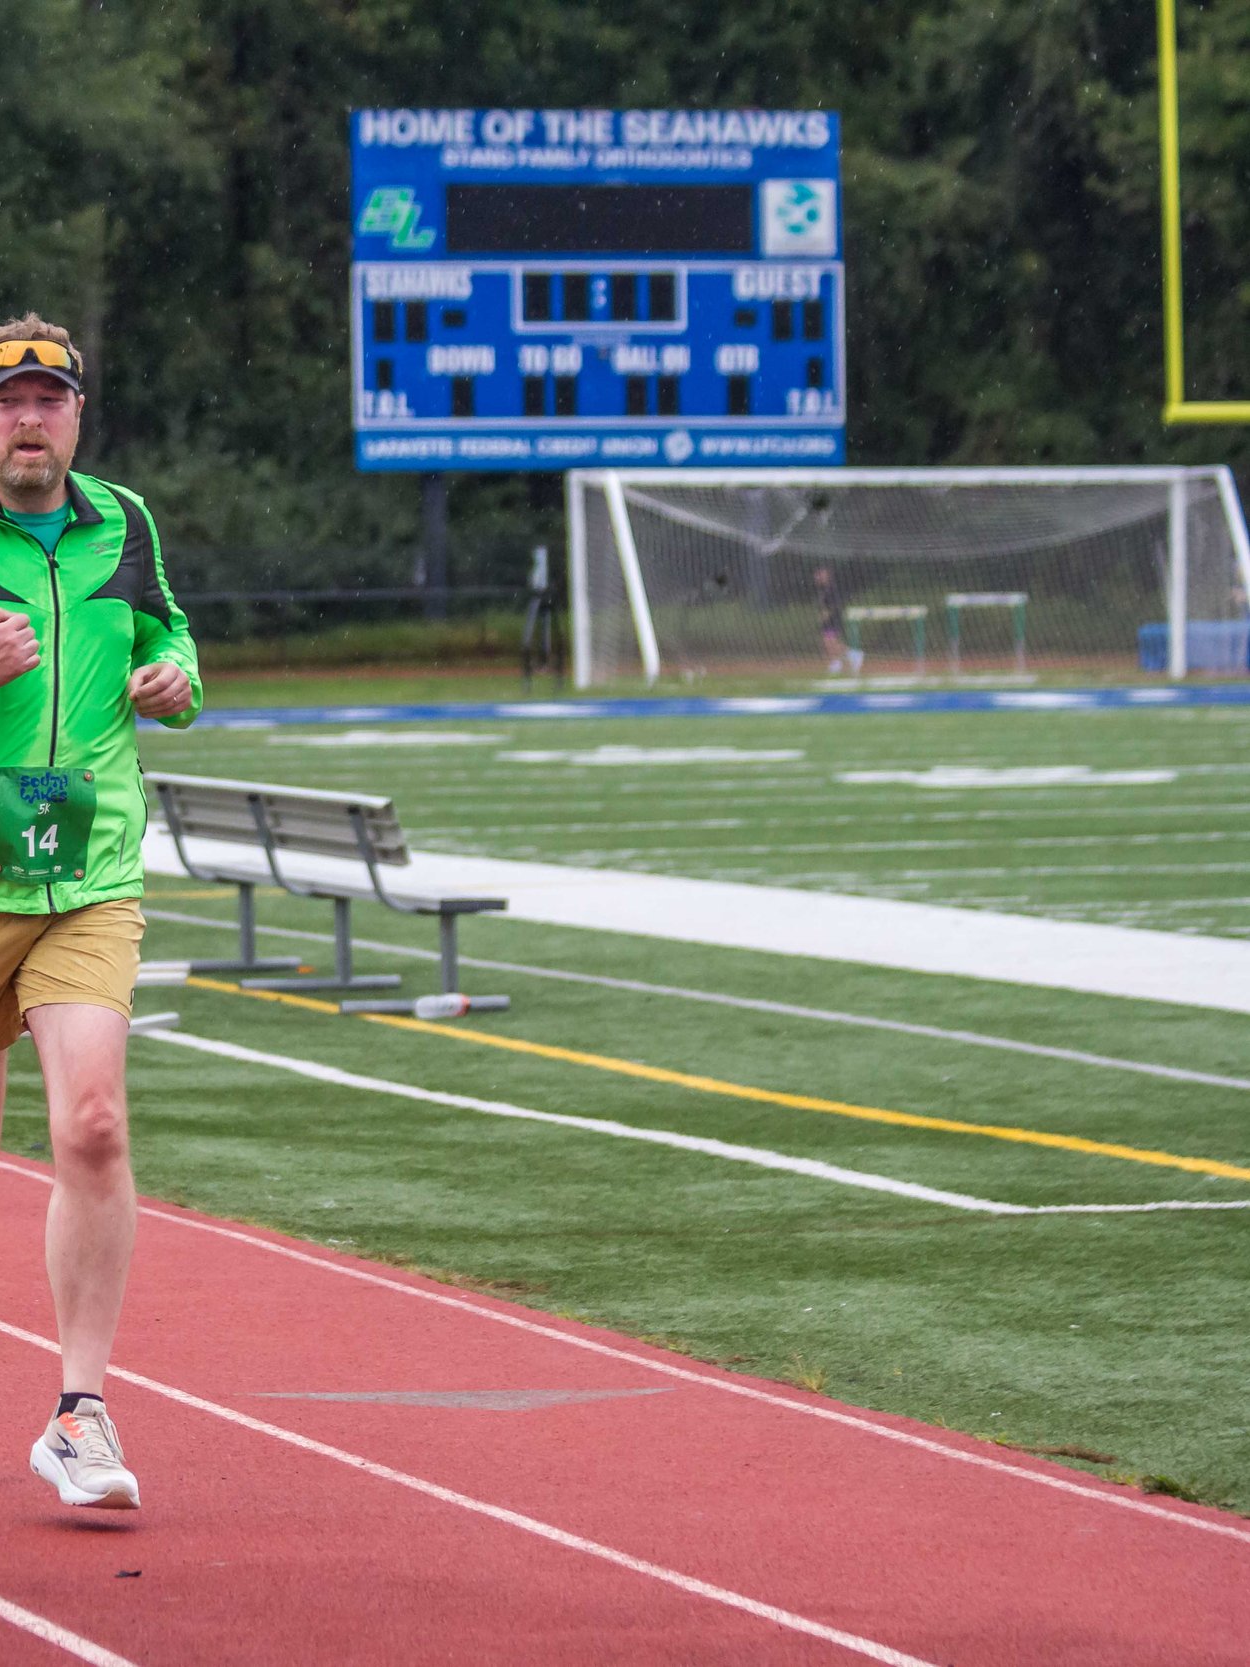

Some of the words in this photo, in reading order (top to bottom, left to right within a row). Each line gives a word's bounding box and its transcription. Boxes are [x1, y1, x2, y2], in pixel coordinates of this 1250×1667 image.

[360, 109, 474, 146] HOME
[481, 109, 534, 146] OF
[542, 109, 613, 146] THE
[621, 109, 829, 149] SEAHAWKS
[518, 147, 591, 168] FAMILY
[593, 148, 753, 169] ORTHODONTICS
[365, 265, 472, 300] SEAHAWKS
[734, 265, 820, 300] GUEST
[427, 344, 496, 375] DOWN
[519, 344, 549, 375] TO
[553, 344, 583, 375] GO
[612, 344, 657, 375] BALL
[661, 344, 691, 375] ON
[715, 344, 760, 375] QTR
[458, 436, 532, 458] FEDERAL
[536, 435, 597, 457] CREDIT
[600, 435, 658, 457] UNION
[20, 771, 68, 791] SOUTH
[20, 786, 67, 804] LAKES
[37, 802, 51, 815] 5K
[21, 824, 59, 858] 14
